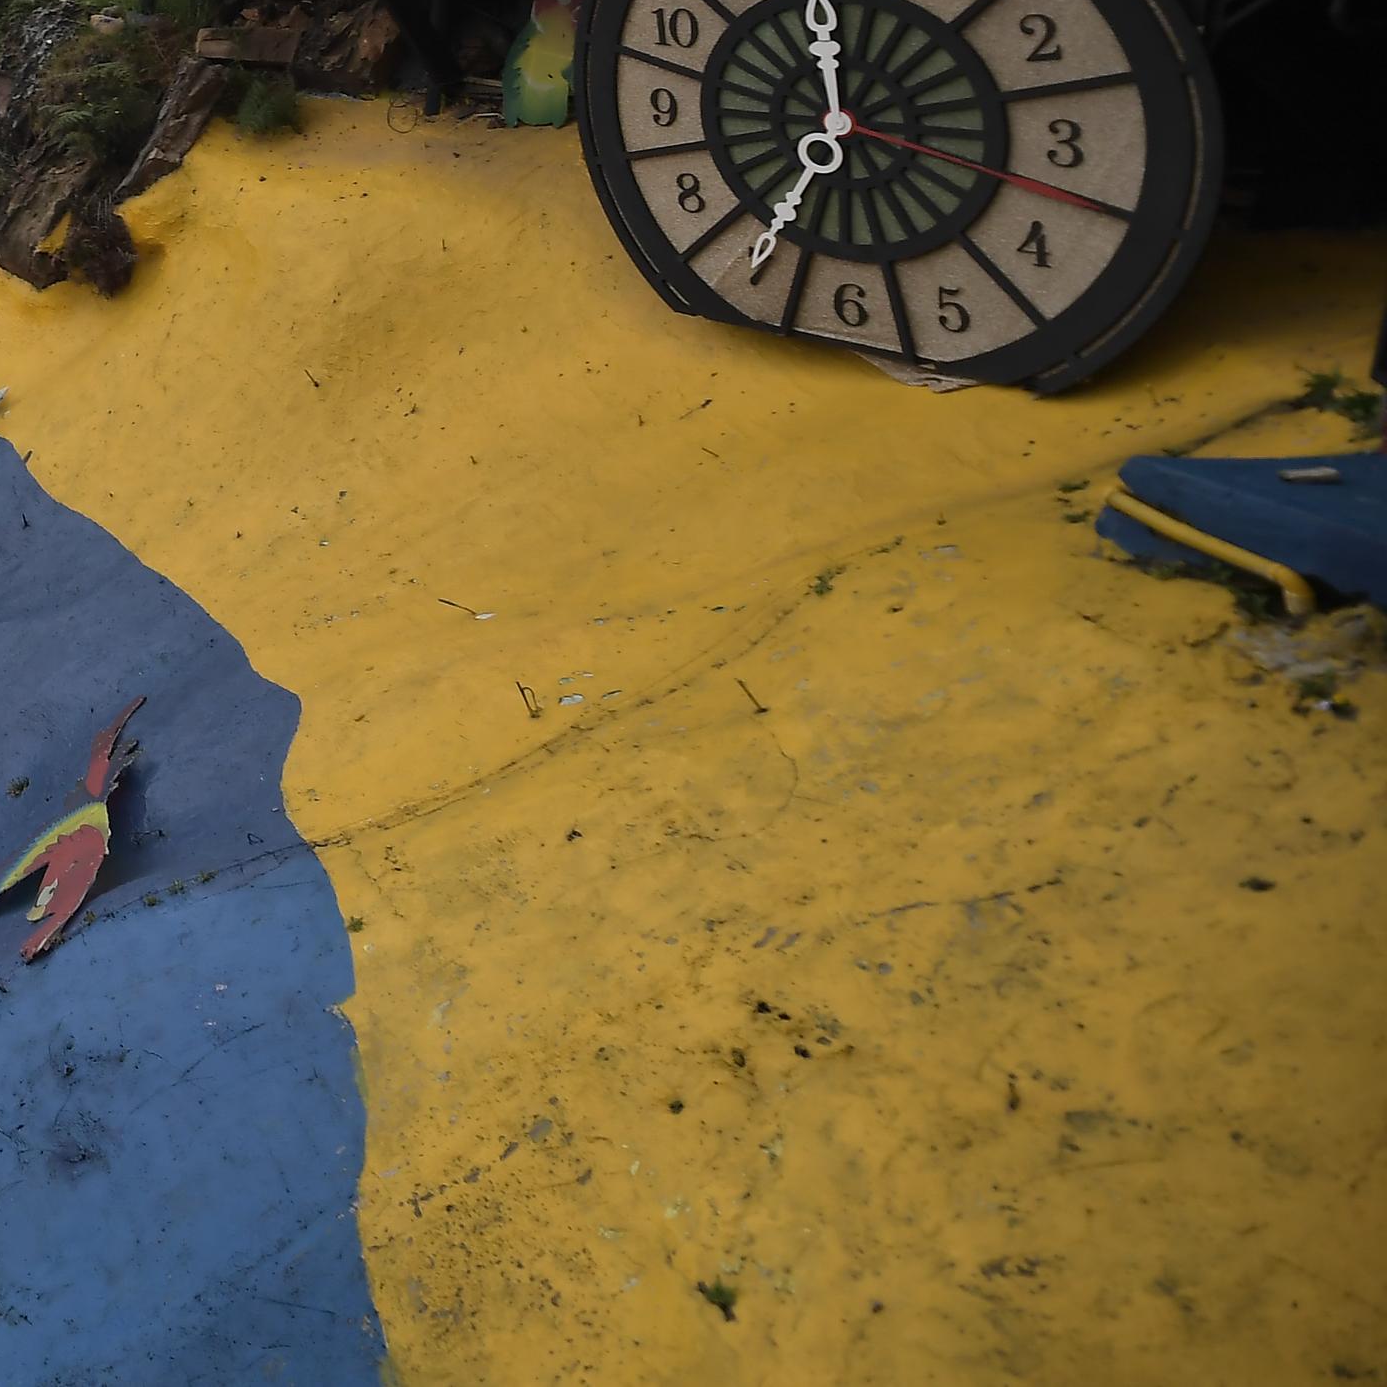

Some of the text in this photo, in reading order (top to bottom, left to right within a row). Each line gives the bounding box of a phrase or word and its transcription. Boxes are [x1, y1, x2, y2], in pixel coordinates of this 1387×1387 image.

[651, 8, 699, 48] 10
[1019, 14, 1063, 62] 2
[651, 88, 679, 127] 9
[1046, 120, 1085, 168] 3
[676, 173, 706, 214] 8
[1017, 220, 1053, 269] 4
[833, 283, 870, 327] 6
[936, 286, 972, 333] 5
